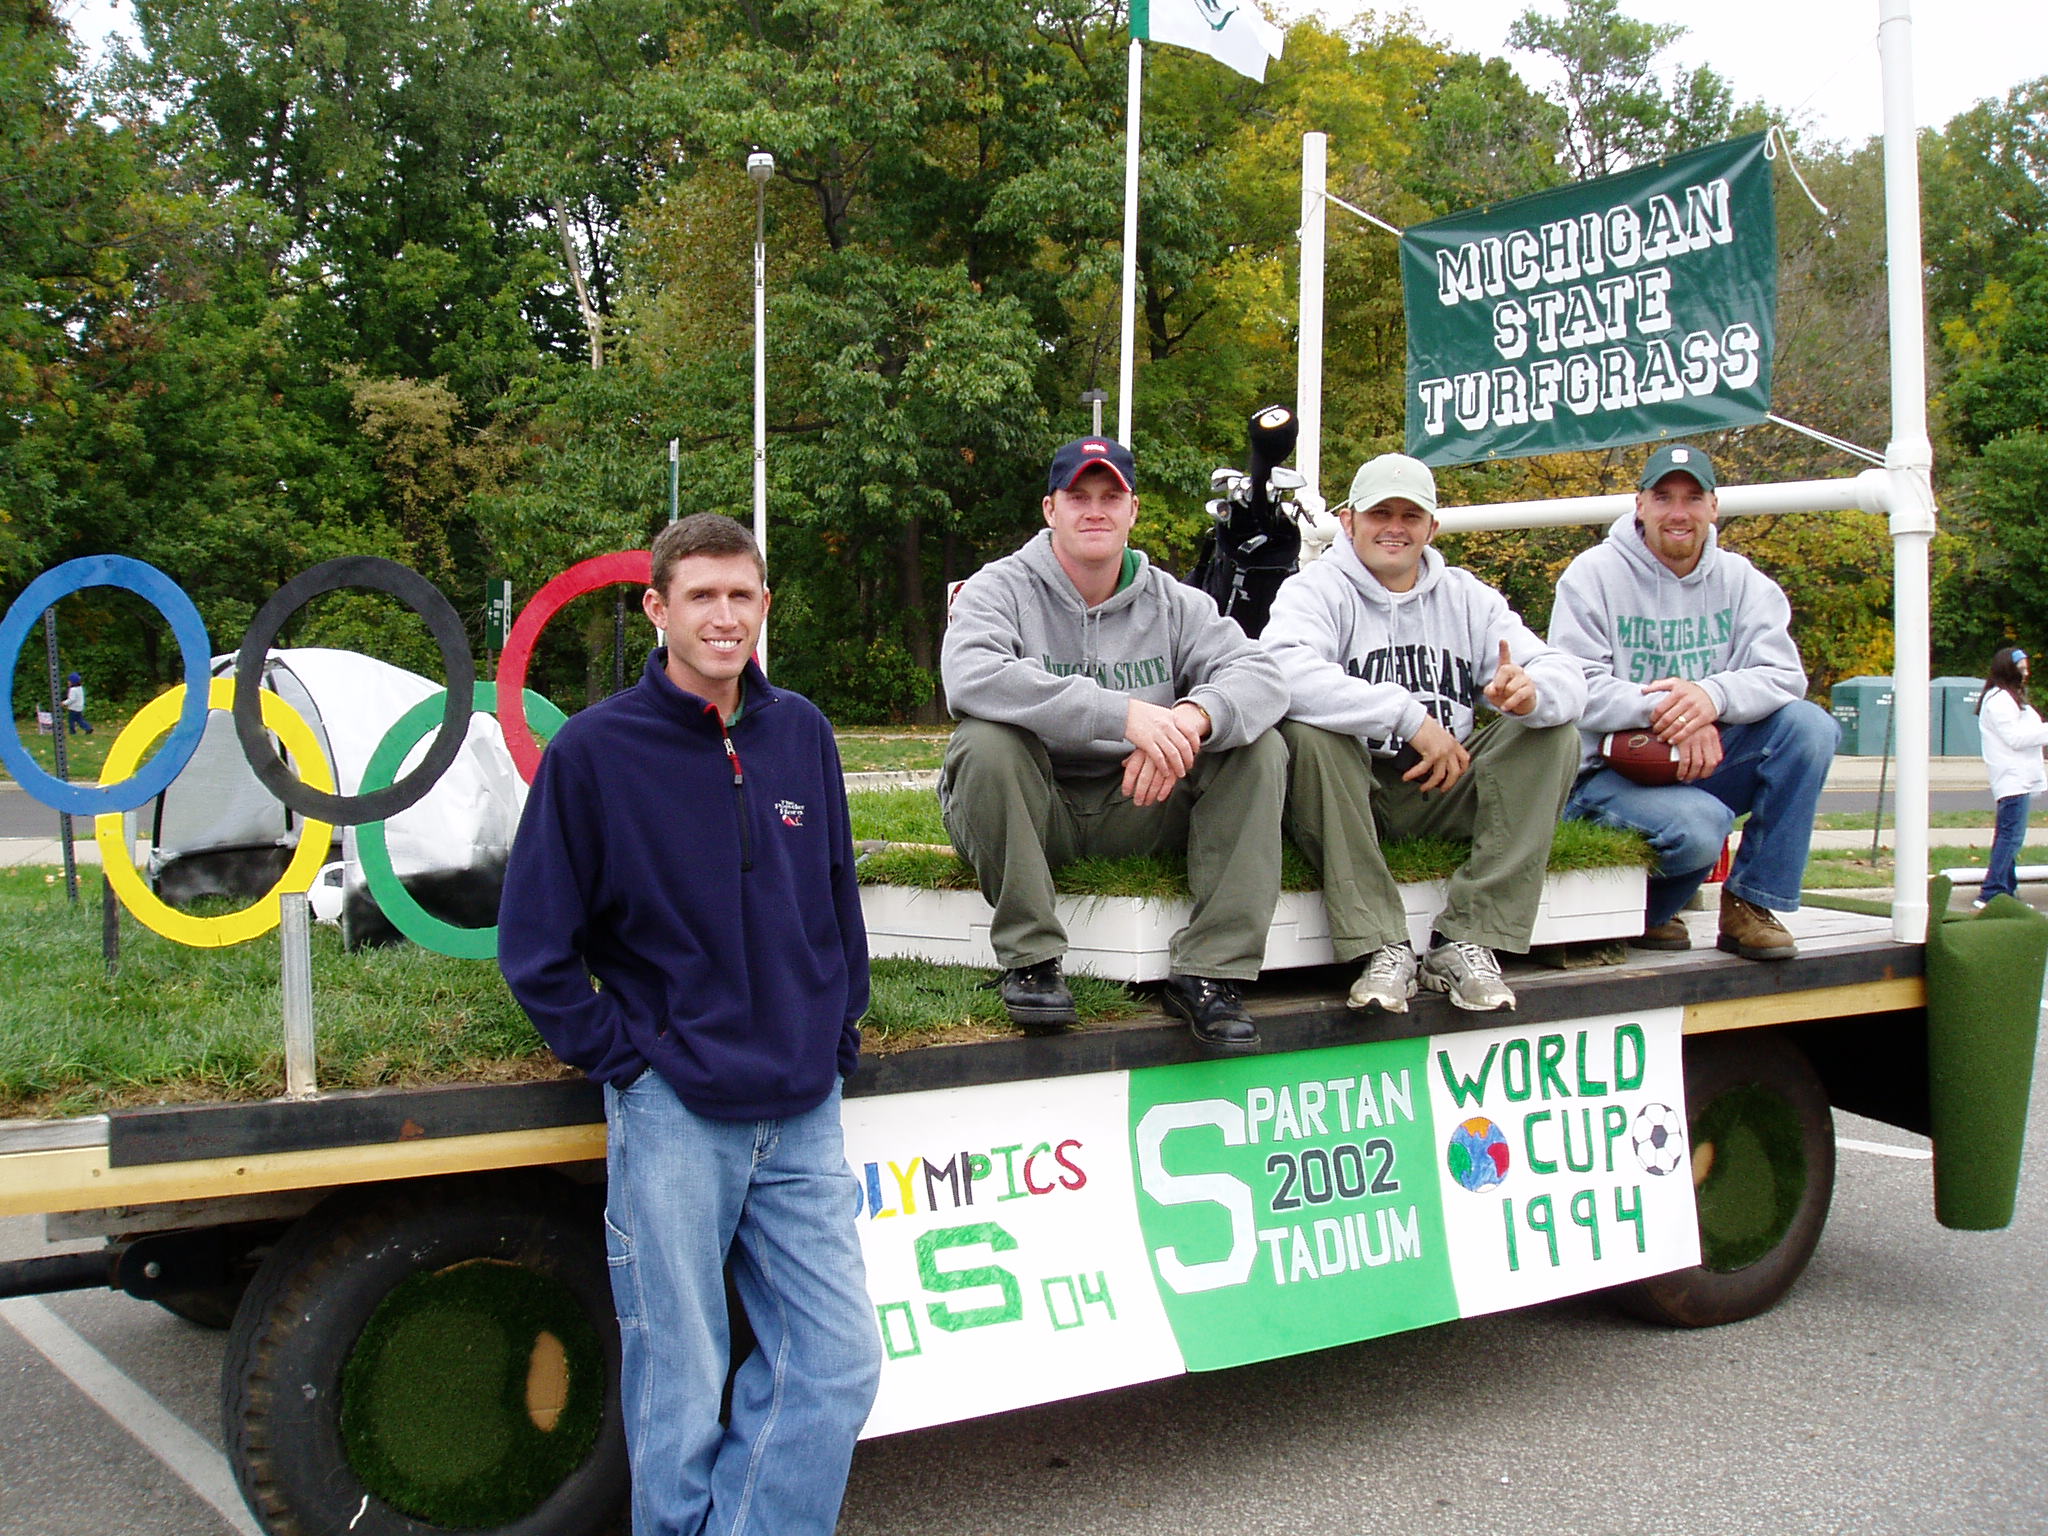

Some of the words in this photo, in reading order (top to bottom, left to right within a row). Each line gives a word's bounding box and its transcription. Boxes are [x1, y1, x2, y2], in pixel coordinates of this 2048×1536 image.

[1436, 178, 1733, 306] MICHIGAN
[1493, 267, 1672, 360] STATE
[1418, 322, 1760, 436] TURFGRASS
[1617, 608, 1733, 652] MICHIGAN
[1114, 656, 1171, 691] STATE
[1437, 1023, 1645, 1109] WORLD
[853, 1139, 1088, 1220] LYMPICS
[1265, 1138, 1400, 1212] 2002
[1523, 1105, 1628, 1175] CUP
[1502, 1185, 1646, 1272] 1994
[913, 1221, 1024, 1333] S
[1040, 1270, 1118, 1331] 04
